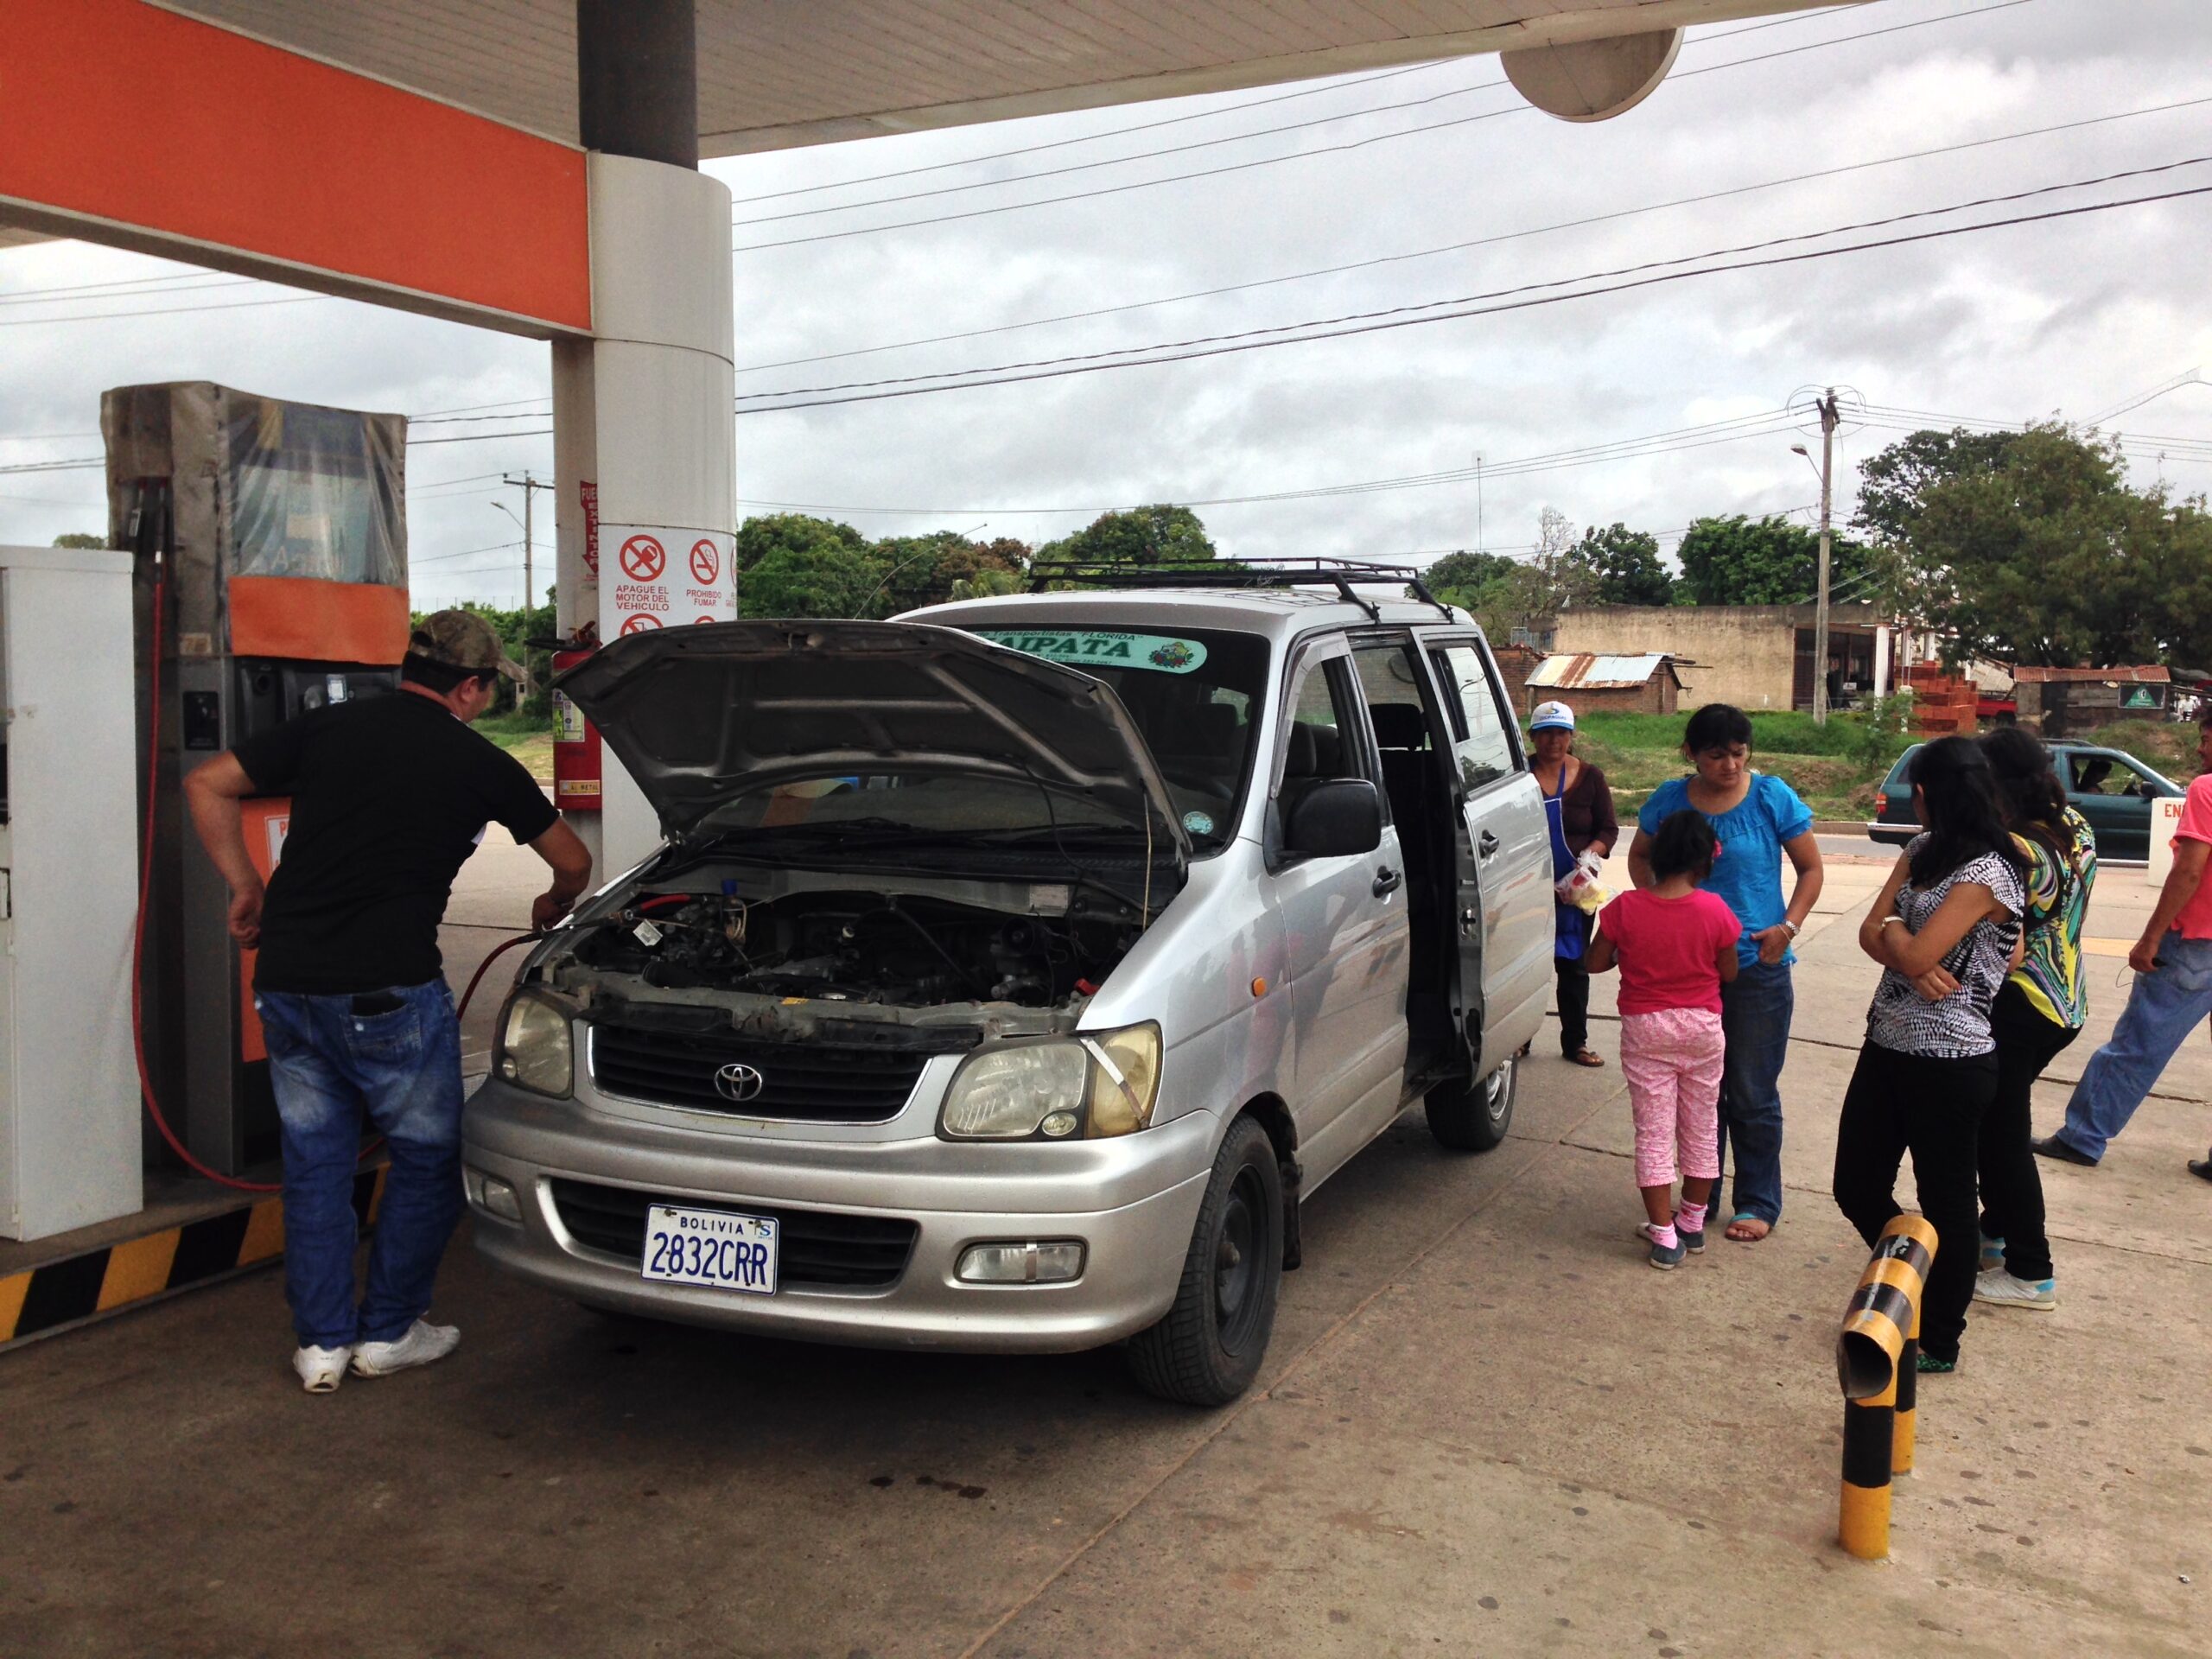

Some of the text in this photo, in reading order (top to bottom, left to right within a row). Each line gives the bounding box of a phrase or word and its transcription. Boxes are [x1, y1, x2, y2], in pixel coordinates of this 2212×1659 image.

[616, 585, 655, 594] APAGUE
[686, 589, 721, 598] PROHIBIDO
[616, 594, 669, 603] MOTOR DEL
[694, 598, 716, 607] FUMAR
[617, 602, 670, 612] VEHICULO
[988, 636, 1131, 658] AIPATA
[2164, 804, 2184, 817] EN
[680, 1217, 745, 1235] BOLIVIA
[650, 1231, 768, 1285] 2832CRR
